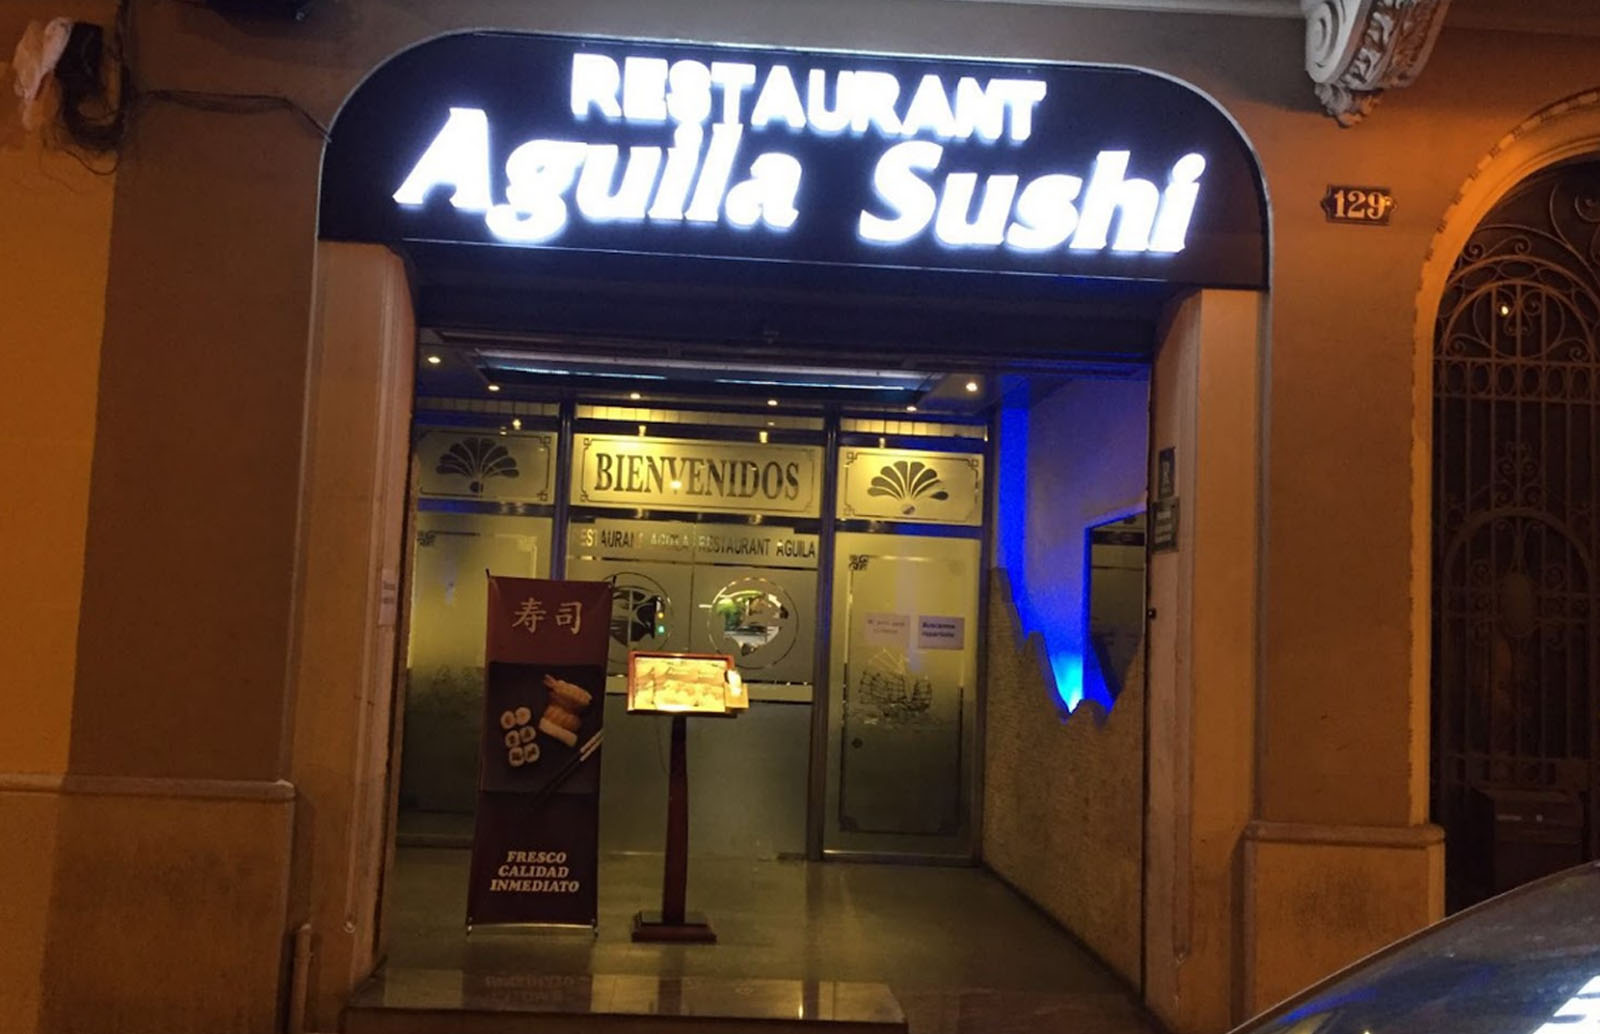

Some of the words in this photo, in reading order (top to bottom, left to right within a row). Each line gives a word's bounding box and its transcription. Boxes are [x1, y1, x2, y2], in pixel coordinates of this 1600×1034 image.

[571, 52, 1048, 142] RESTAURANT
[858, 139, 1207, 254] Sushi
[1334, 189, 1386, 220] 129
[593, 452, 800, 501] BIENVENIDOS
[775, 539, 816, 559] AGUILA
[512, 597, 583, 635] 寿司
[498, 865, 570, 879] CALIDAD
[506, 850, 568, 864] FRESCO
[489, 879, 580, 893] INMEDIATO
